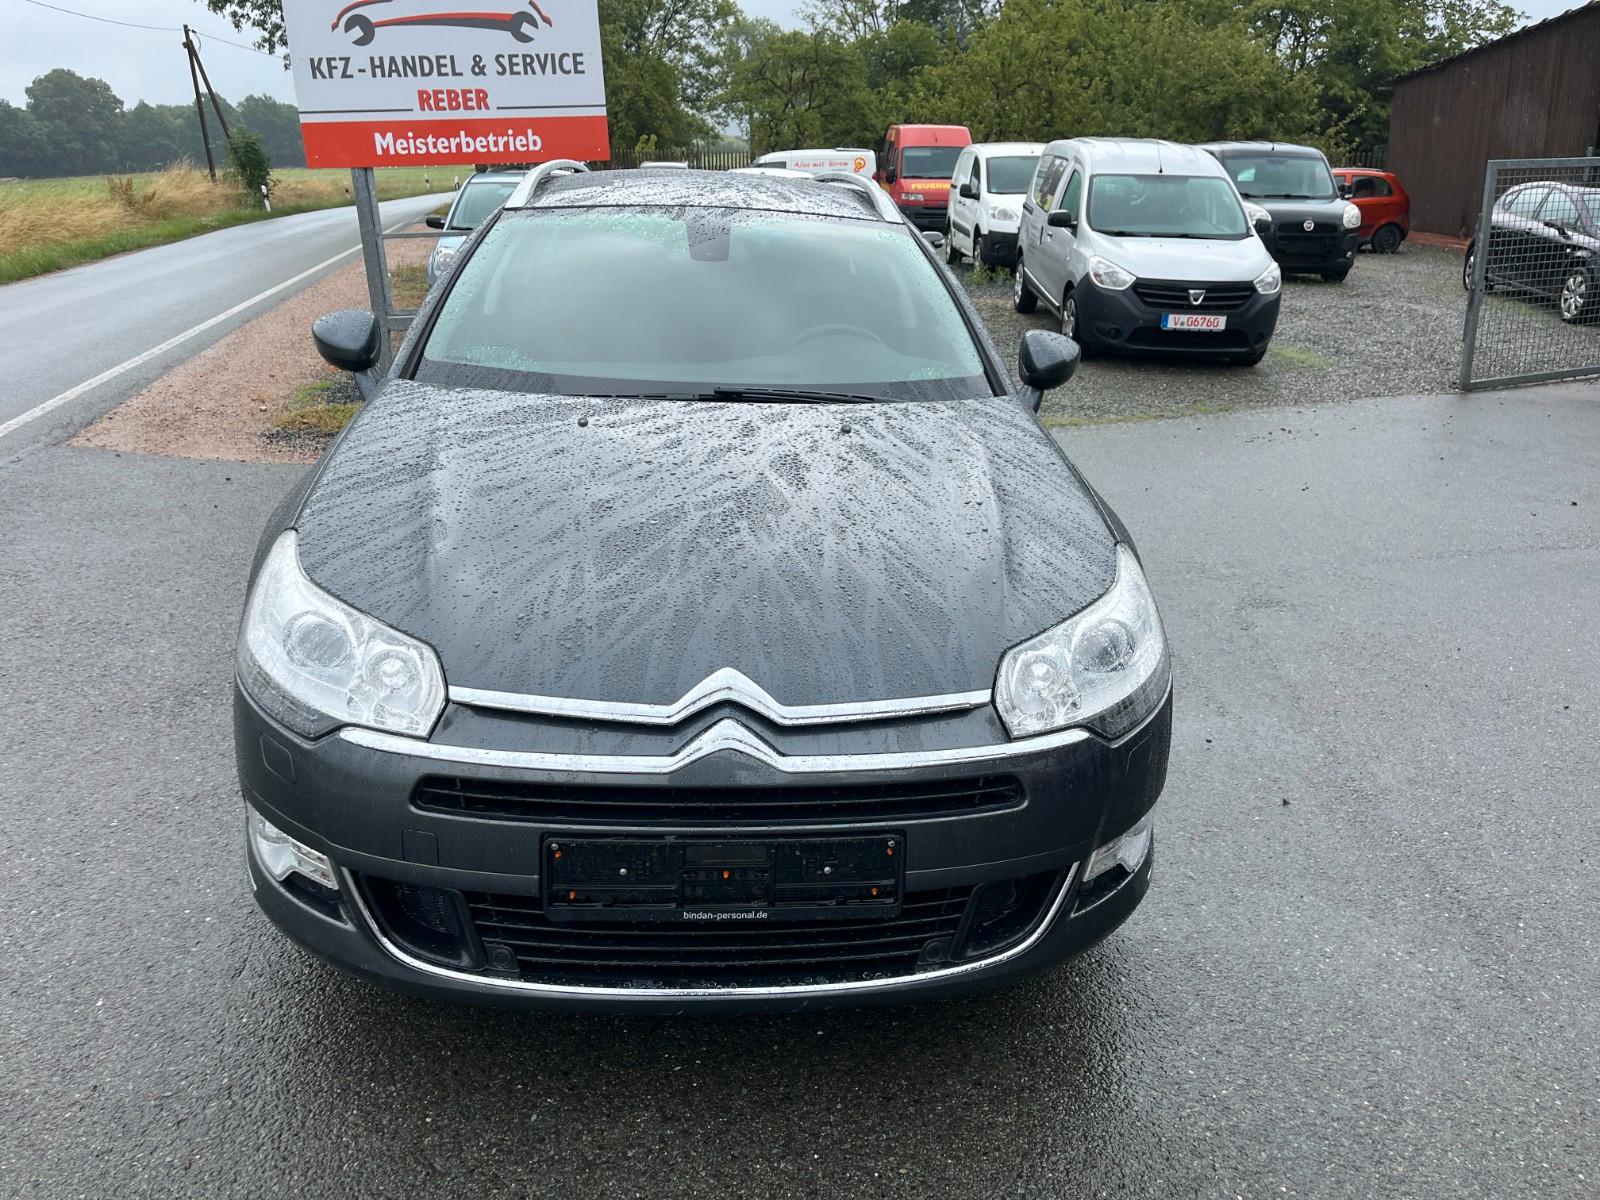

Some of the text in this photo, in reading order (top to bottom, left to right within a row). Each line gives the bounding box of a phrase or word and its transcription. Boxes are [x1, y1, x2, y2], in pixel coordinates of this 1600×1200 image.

[309, 52, 586, 79] KFZ-HANDEL & SERVICE
[417, 88, 490, 112] REBER
[374, 129, 542, 156] Meisterbetrieb
[1173, 316, 1220, 328] V 06760
[683, 911, 768, 920] bindan-personal.de
